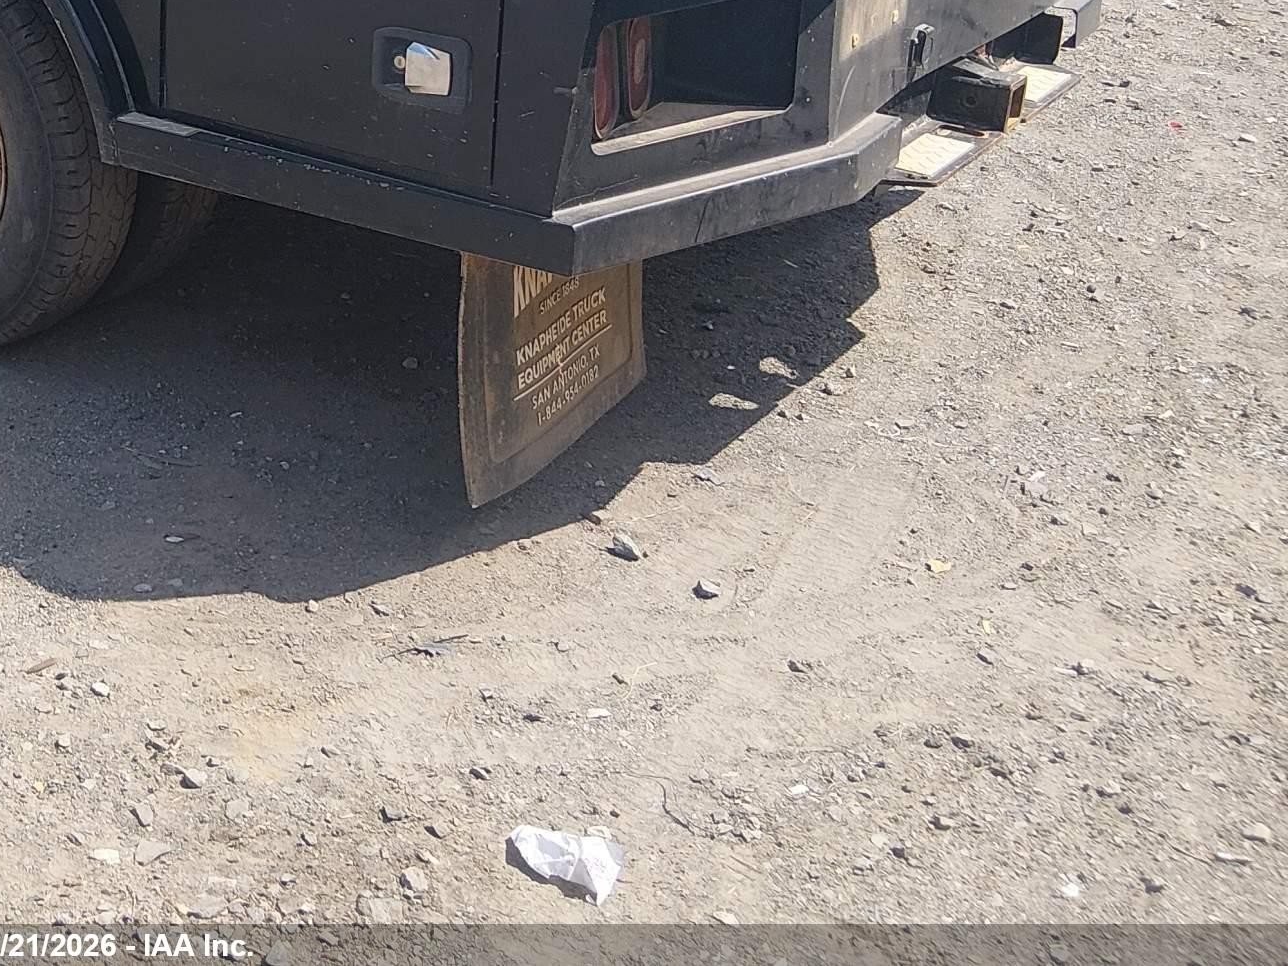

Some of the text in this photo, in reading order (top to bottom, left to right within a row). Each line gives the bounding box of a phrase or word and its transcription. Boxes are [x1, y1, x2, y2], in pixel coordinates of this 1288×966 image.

[517, 286, 607, 365] KNAPHEIDE TRUCK
[539, 288, 561, 315] SINCE
[518, 309, 608, 390] EQUIPMENT CENTER
[532, 385, 552, 410] SAN
[589, 343, 601, 361] TX
[538, 364, 600, 426] 1-844-954-0182
